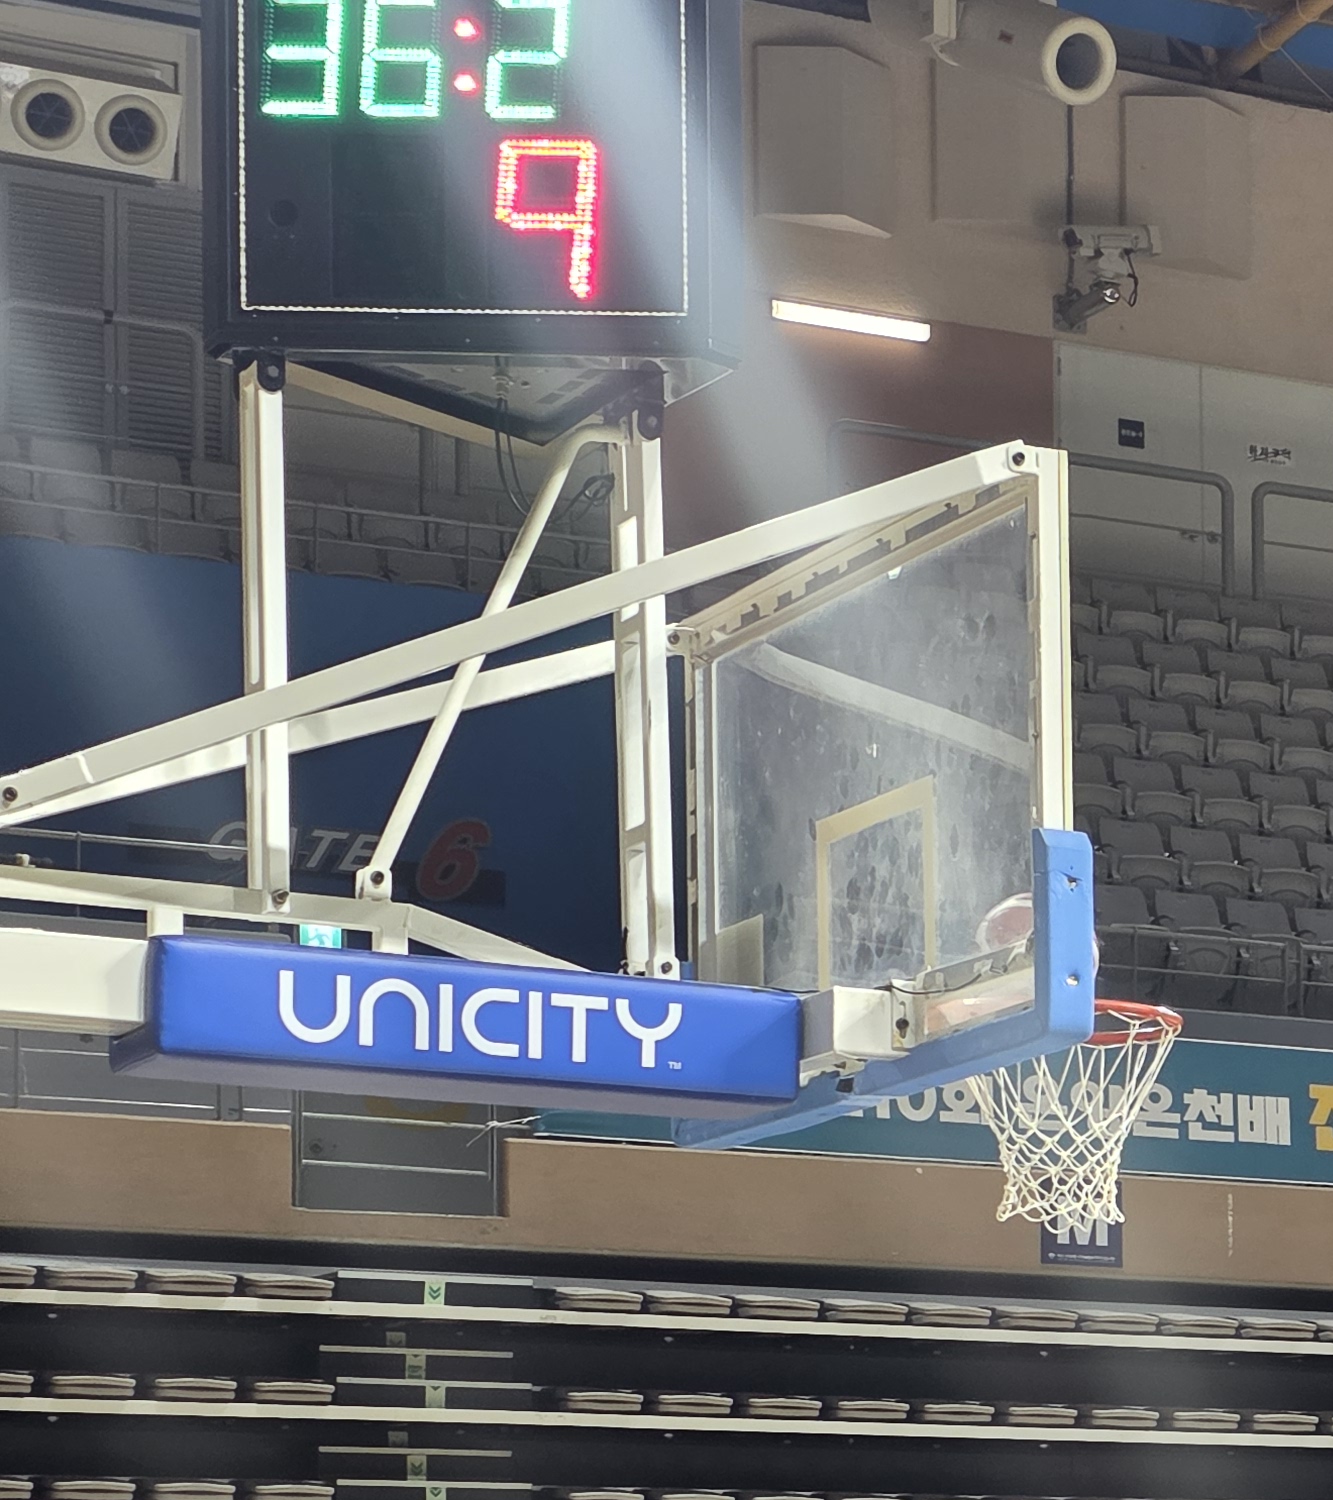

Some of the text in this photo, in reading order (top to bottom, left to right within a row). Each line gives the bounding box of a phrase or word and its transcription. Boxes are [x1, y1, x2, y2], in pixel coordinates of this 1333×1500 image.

[495, 138, 600, 300] 9
[208, 818, 491, 900] GTE 6
[278, 969, 683, 1068] UNICITY
